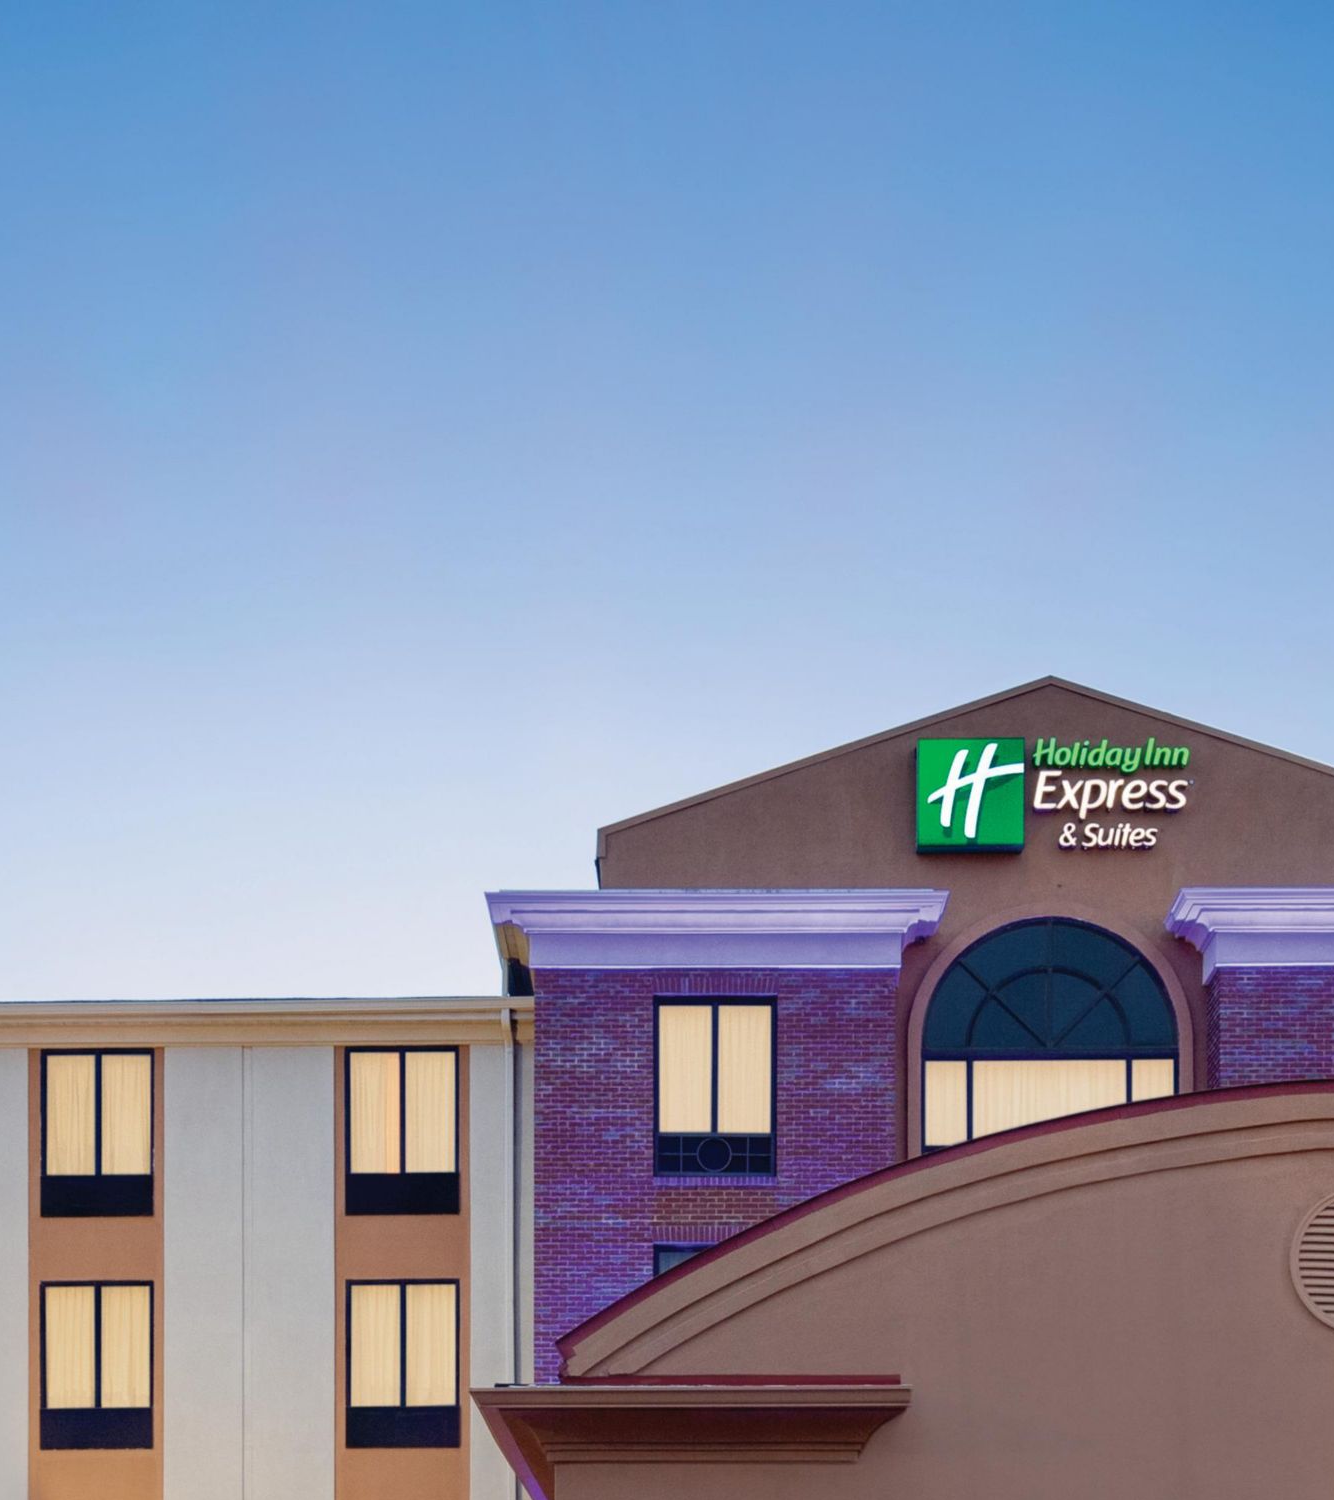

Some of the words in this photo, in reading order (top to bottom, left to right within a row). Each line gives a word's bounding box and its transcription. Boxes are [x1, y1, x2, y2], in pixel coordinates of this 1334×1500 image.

[1032, 737, 1142, 773] Holiday
[1144, 737, 1190, 766] Inn
[1033, 770, 1188, 820] Express
[1059, 822, 1077, 847] &
[1081, 822, 1158, 847] Suites
